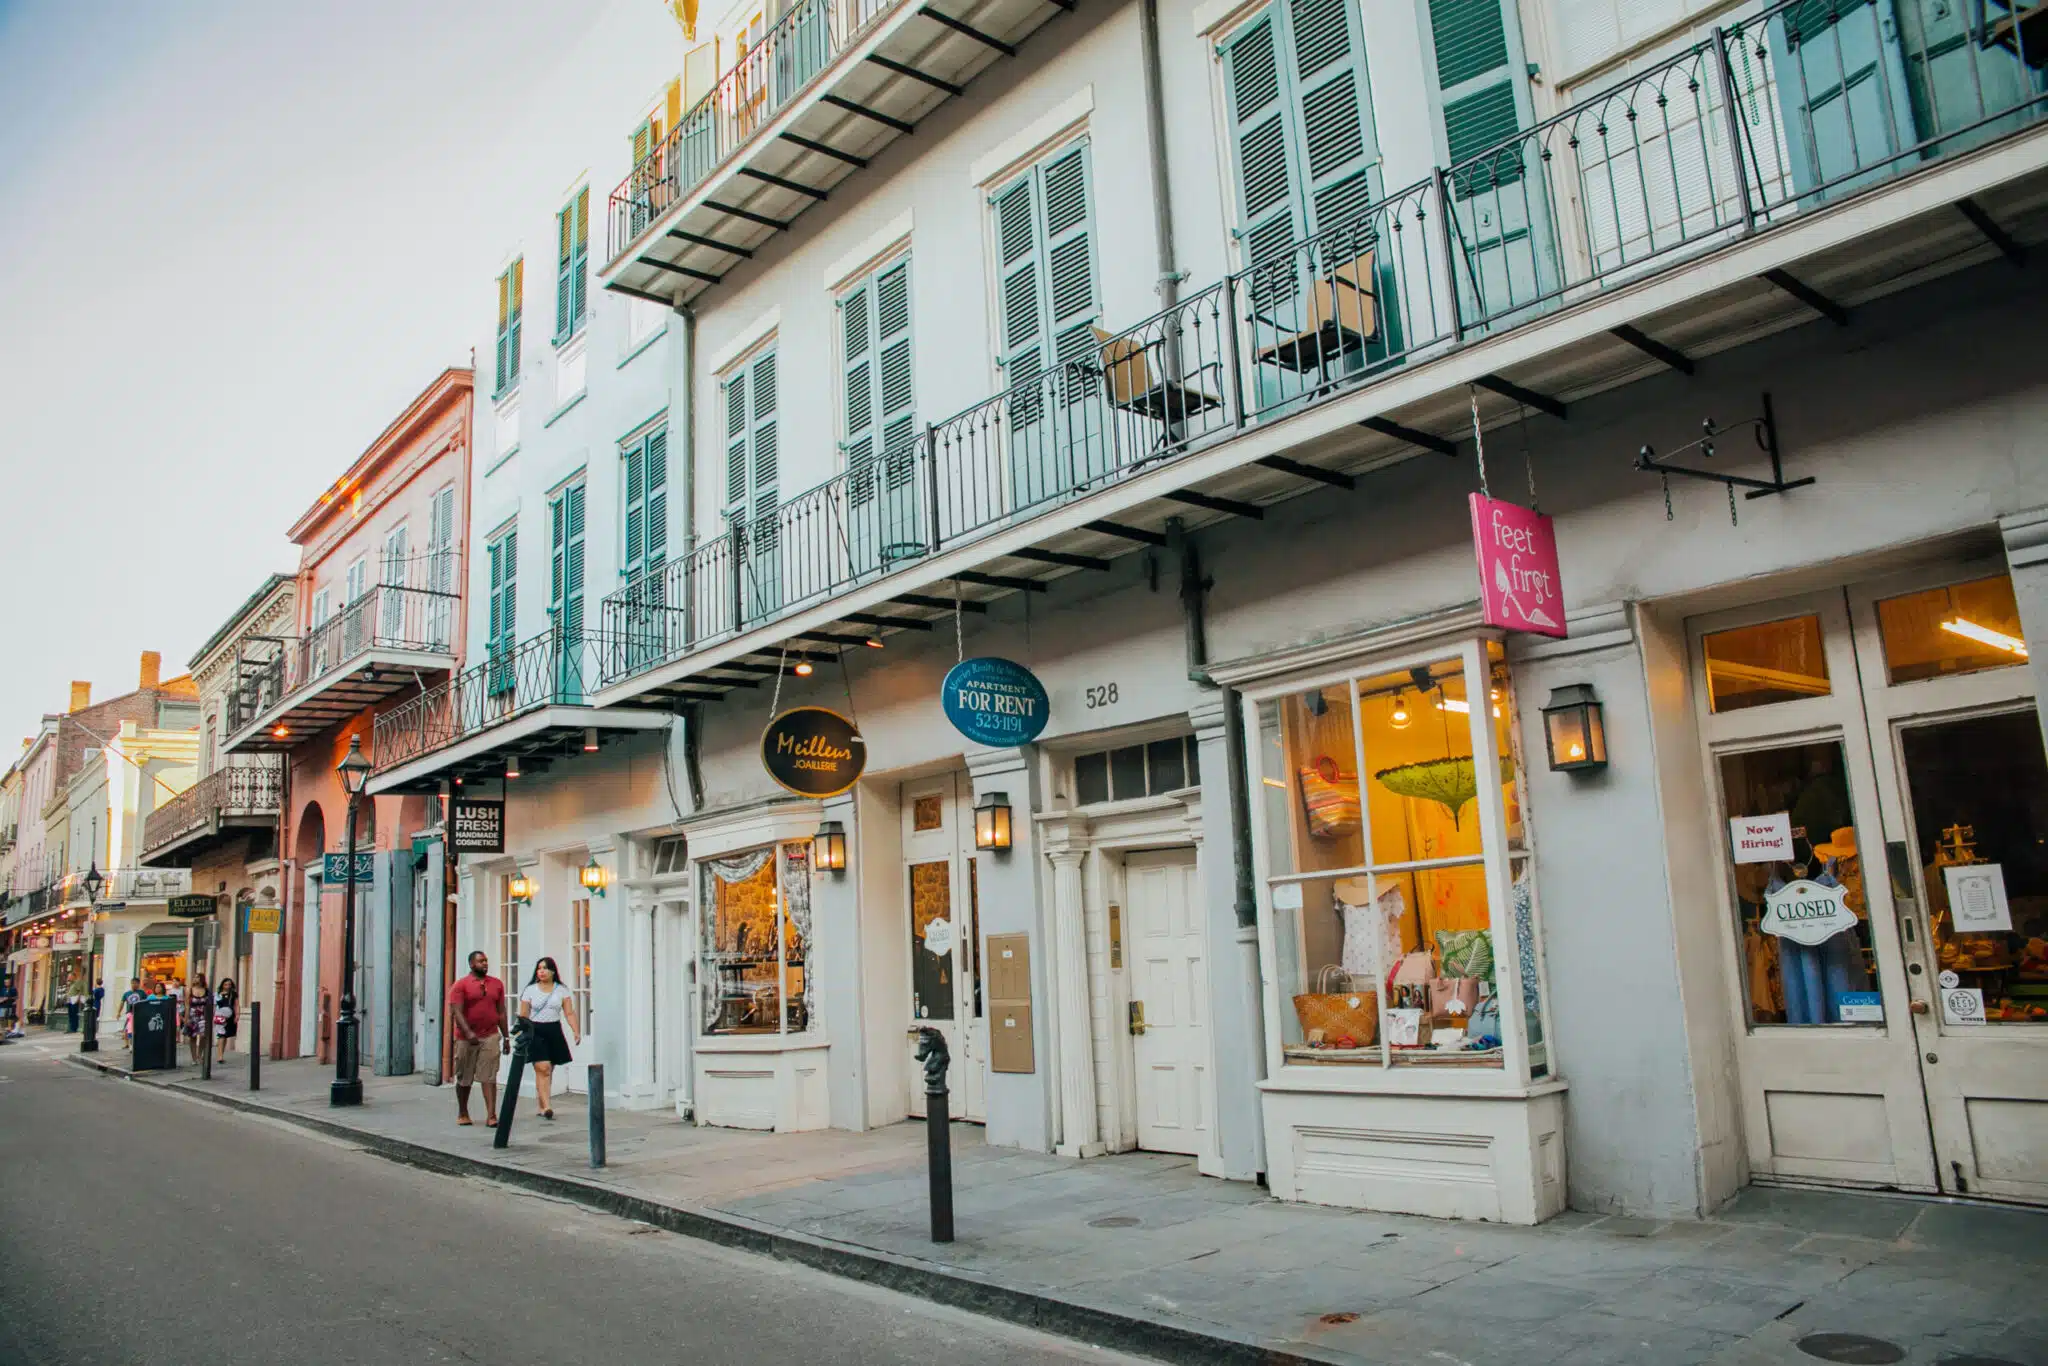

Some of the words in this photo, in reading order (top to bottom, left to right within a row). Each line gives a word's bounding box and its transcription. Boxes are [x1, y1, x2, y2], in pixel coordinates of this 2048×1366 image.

[1492, 509, 1536, 555] feet
[1511, 554, 1553, 604] first
[966, 680, 1027, 694] APARTMENT
[1086, 682, 1119, 709] 528
[958, 689, 991, 712] FOR
[994, 693, 1036, 717] RENT
[792, 759, 838, 772] JOAILLERIE
[456, 806, 500, 819] LUSH
[456, 820, 499, 831] FRESH
[1746, 825, 1775, 835] Now
[1741, 837, 1784, 850] Hiring!
[1776, 899, 1836, 920] CLOSED
[1842, 995, 1877, 1006] Google
